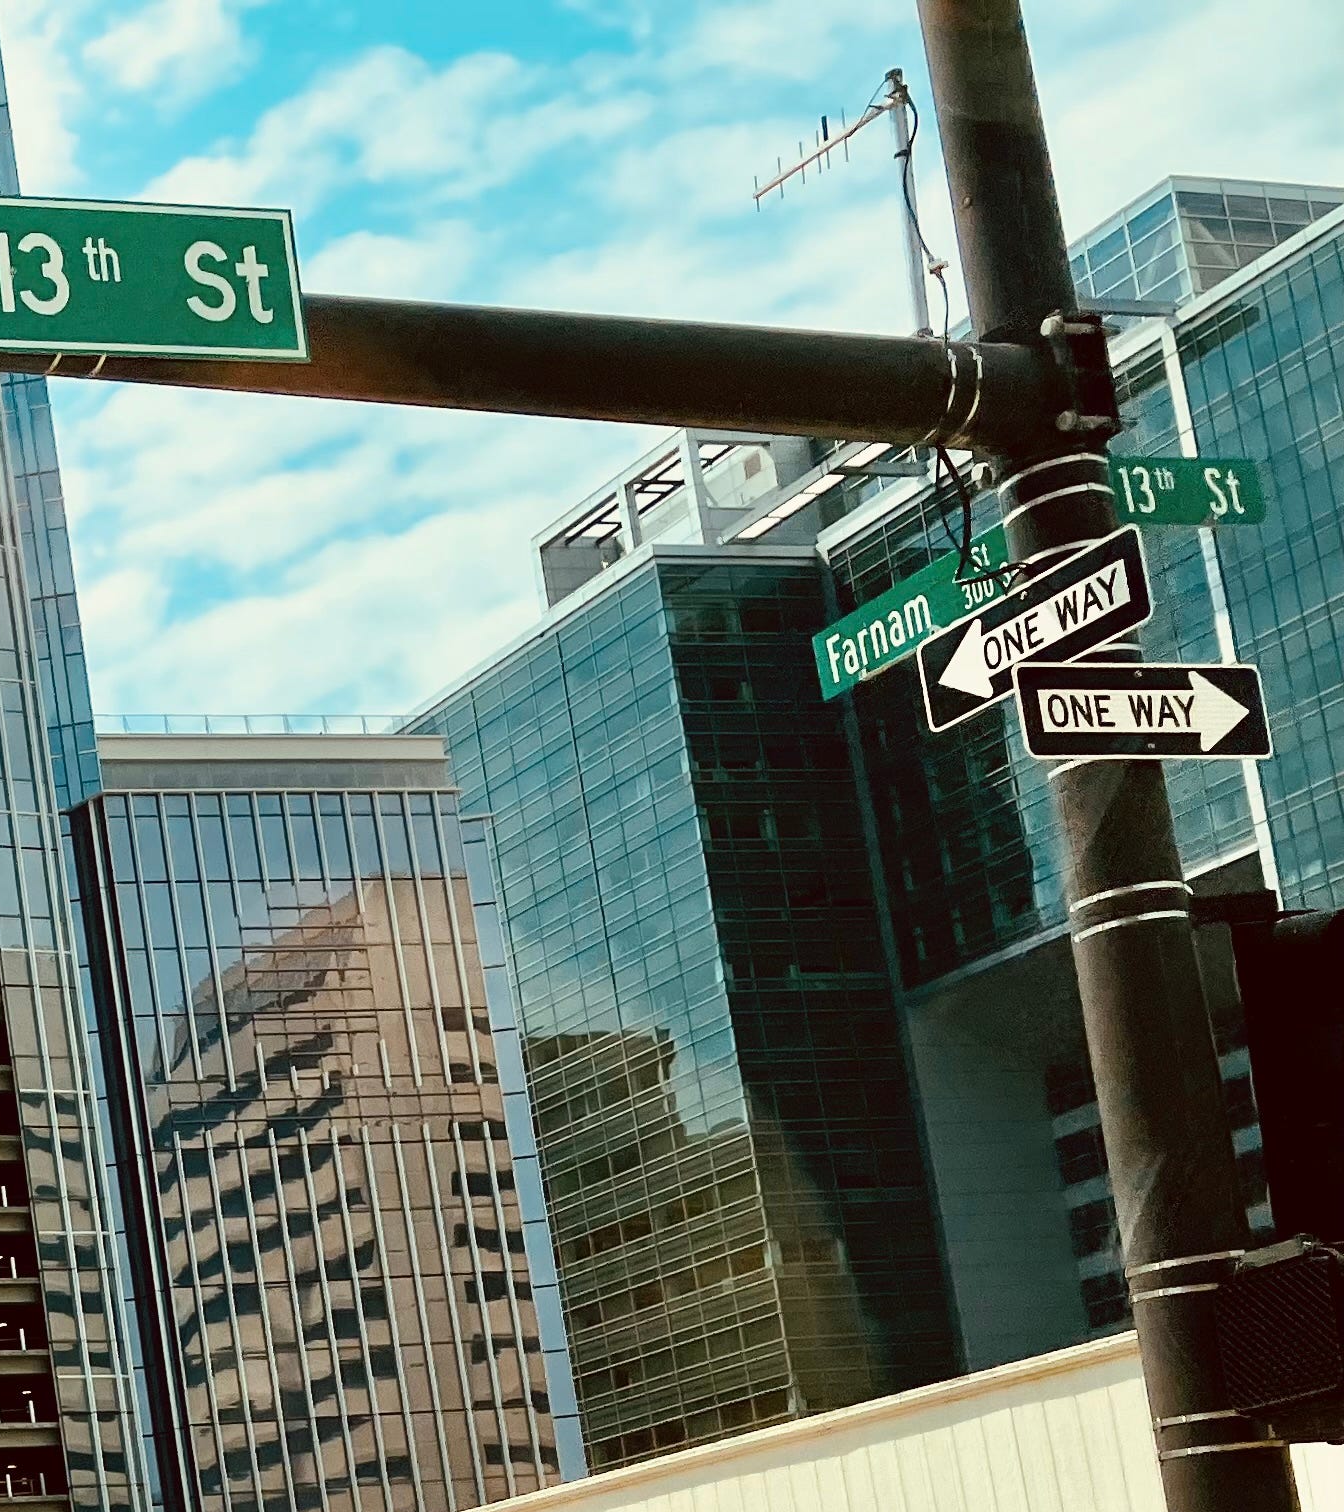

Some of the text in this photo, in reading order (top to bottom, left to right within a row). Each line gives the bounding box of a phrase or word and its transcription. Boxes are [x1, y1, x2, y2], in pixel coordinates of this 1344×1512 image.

[184, 241, 274, 324] St
[1118, 464, 1245, 517] 13th St
[826, 543, 991, 683] Farnam St
[962, 579, 995, 610] 300
[983, 567, 1118, 670] ONE WAY
[1046, 693, 1195, 728] ONE WAY
